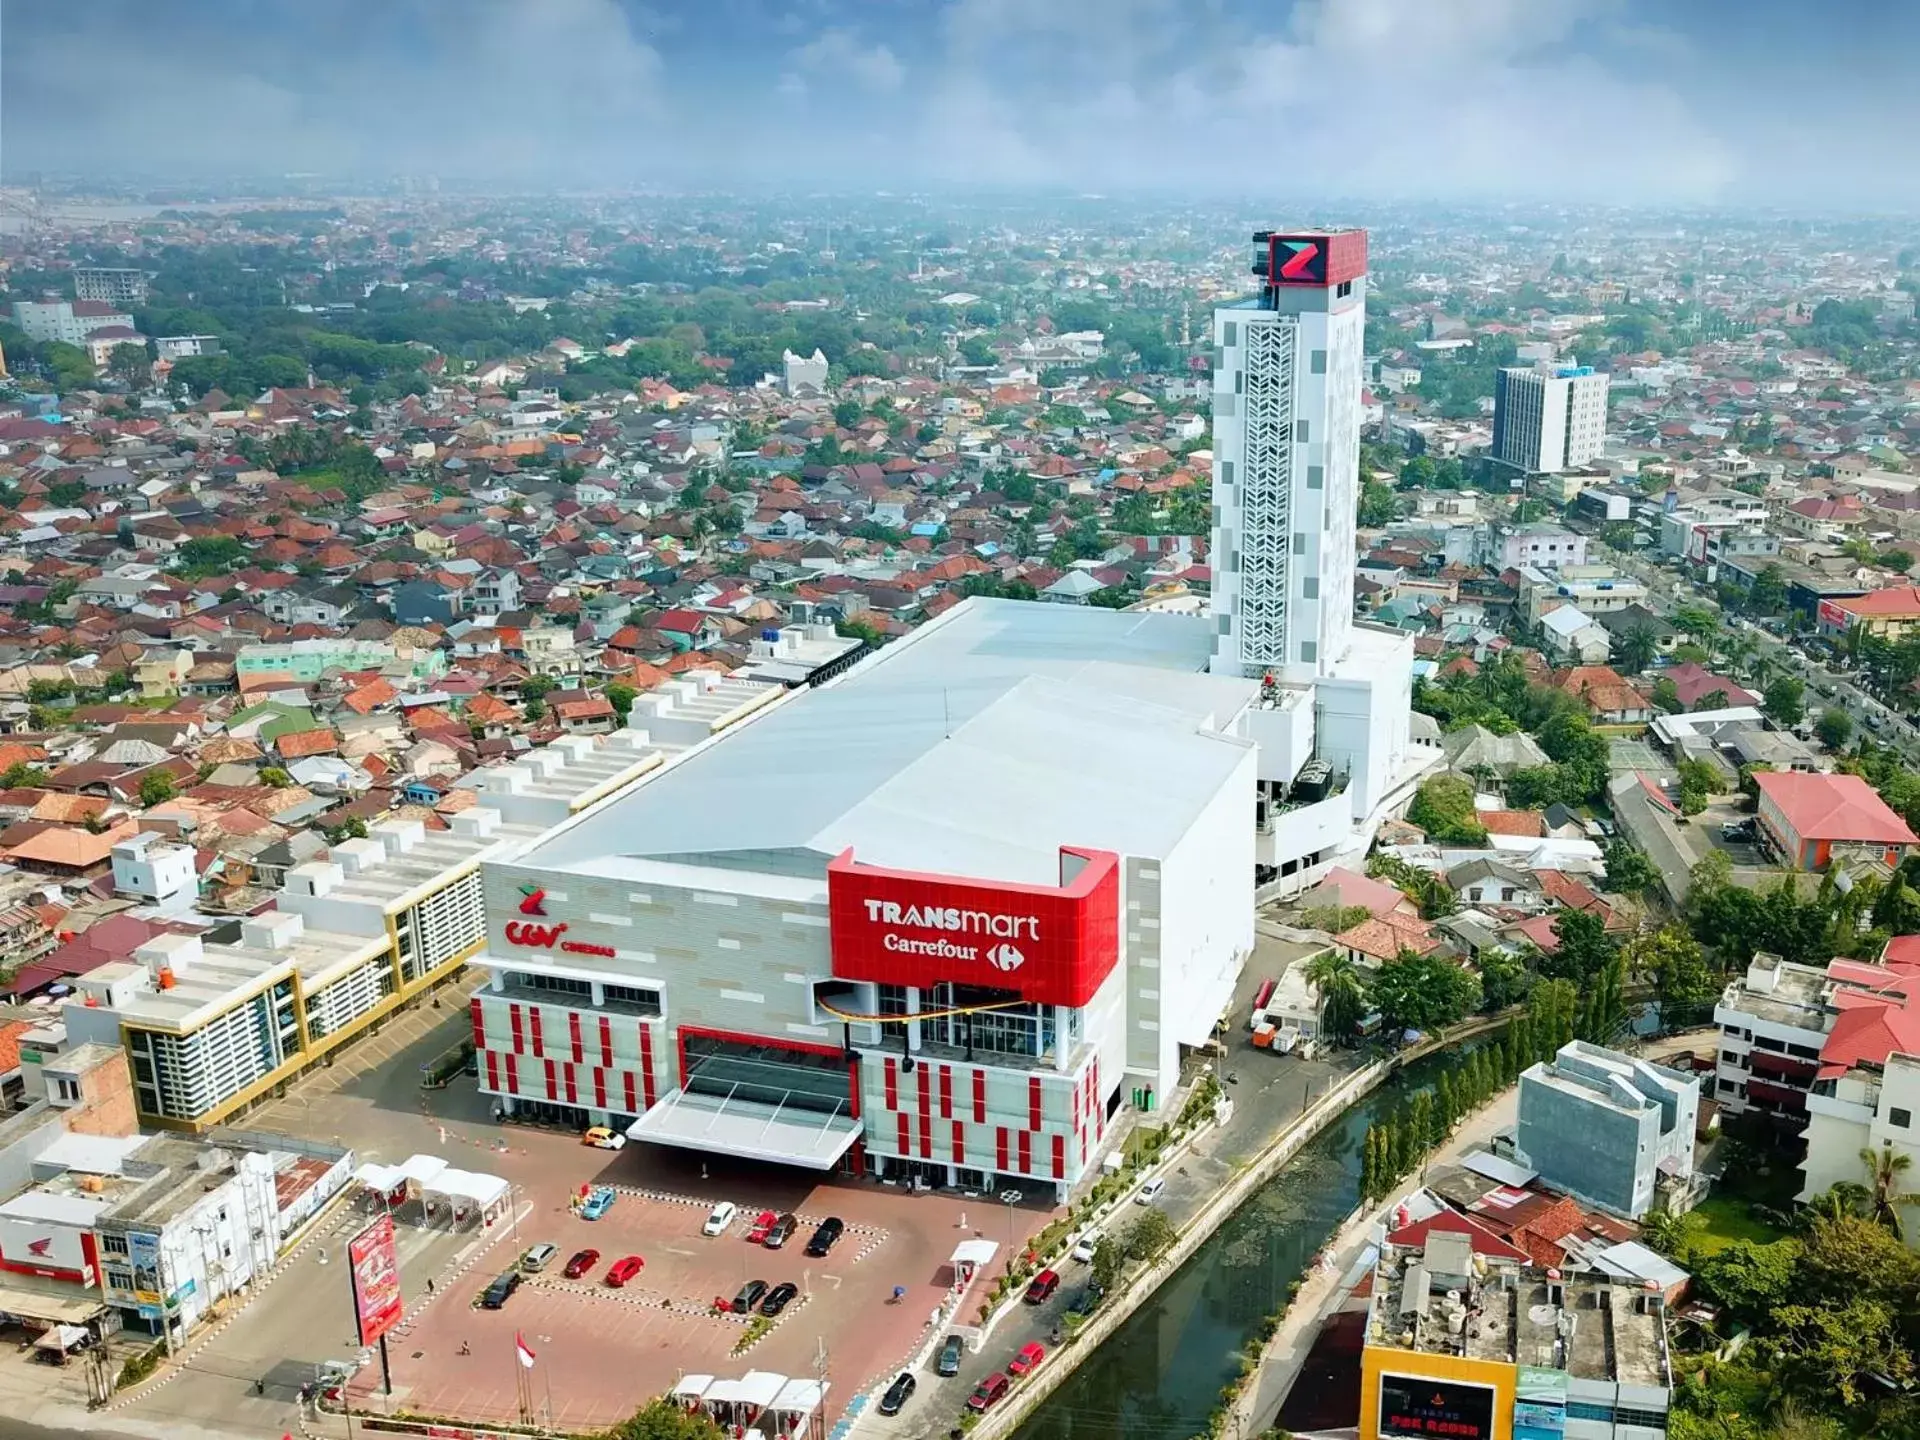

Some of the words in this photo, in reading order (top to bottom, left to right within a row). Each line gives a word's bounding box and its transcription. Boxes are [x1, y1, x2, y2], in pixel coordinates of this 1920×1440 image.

[863, 899, 1040, 941] TRANSmart
[505, 921, 567, 949] CGV
[883, 933, 978, 960] Carrefour
